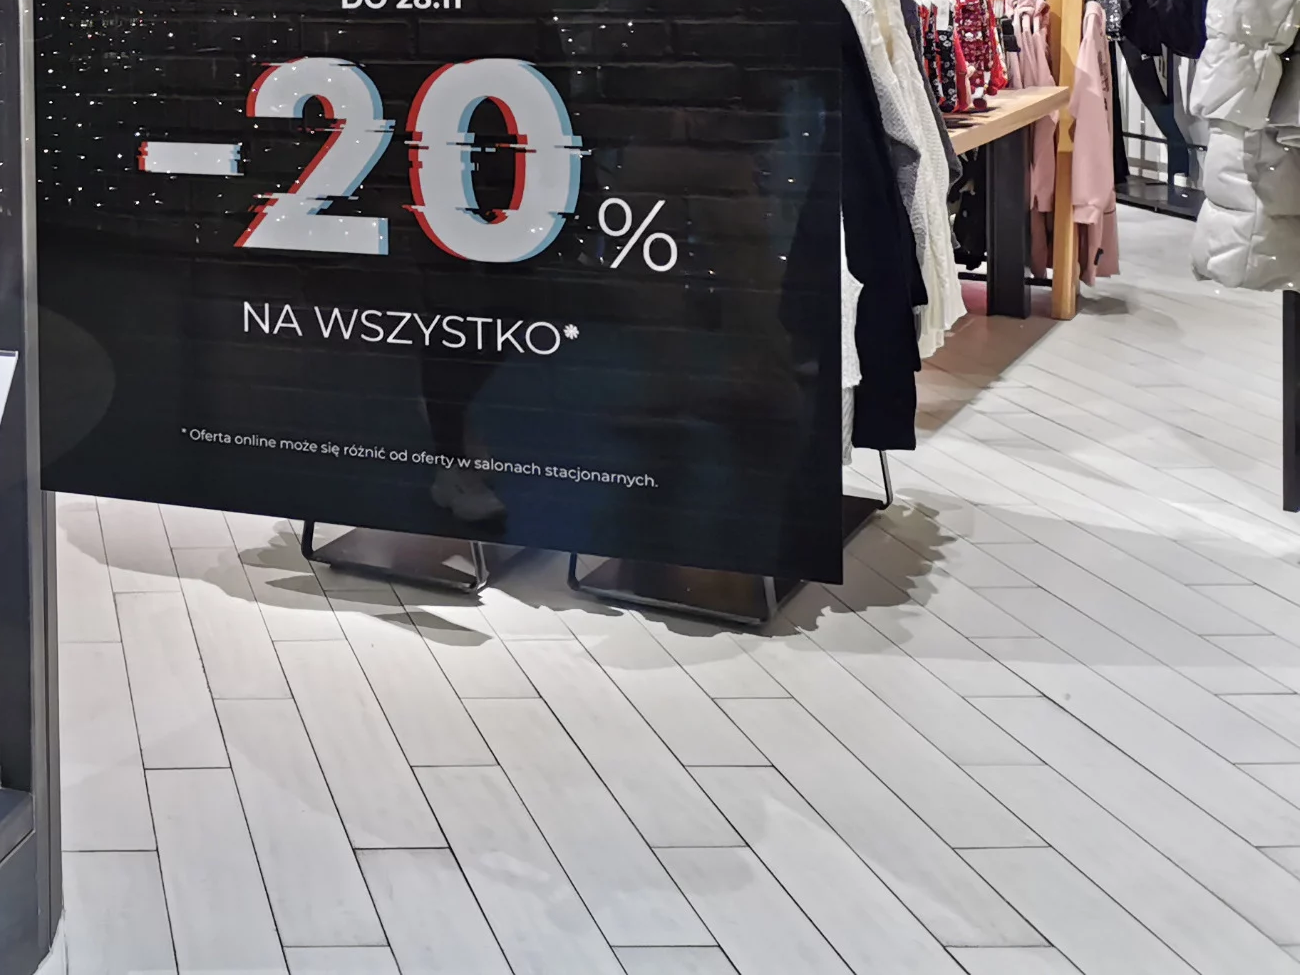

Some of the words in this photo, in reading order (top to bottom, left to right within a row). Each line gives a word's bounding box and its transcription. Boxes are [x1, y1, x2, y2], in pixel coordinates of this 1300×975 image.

[243, 301, 303, 337] NA
[234, 434, 277, 448] online
[280, 438, 318, 453] może
[321, 441, 340, 457] się
[343, 444, 386, 460] różnić
[389, 450, 408, 462] od
[411, 450, 454, 469] oferty
[457, 457, 470, 468] w
[474, 458, 541, 475] salonach
[545, 465, 659, 488] stacjonarnych.
